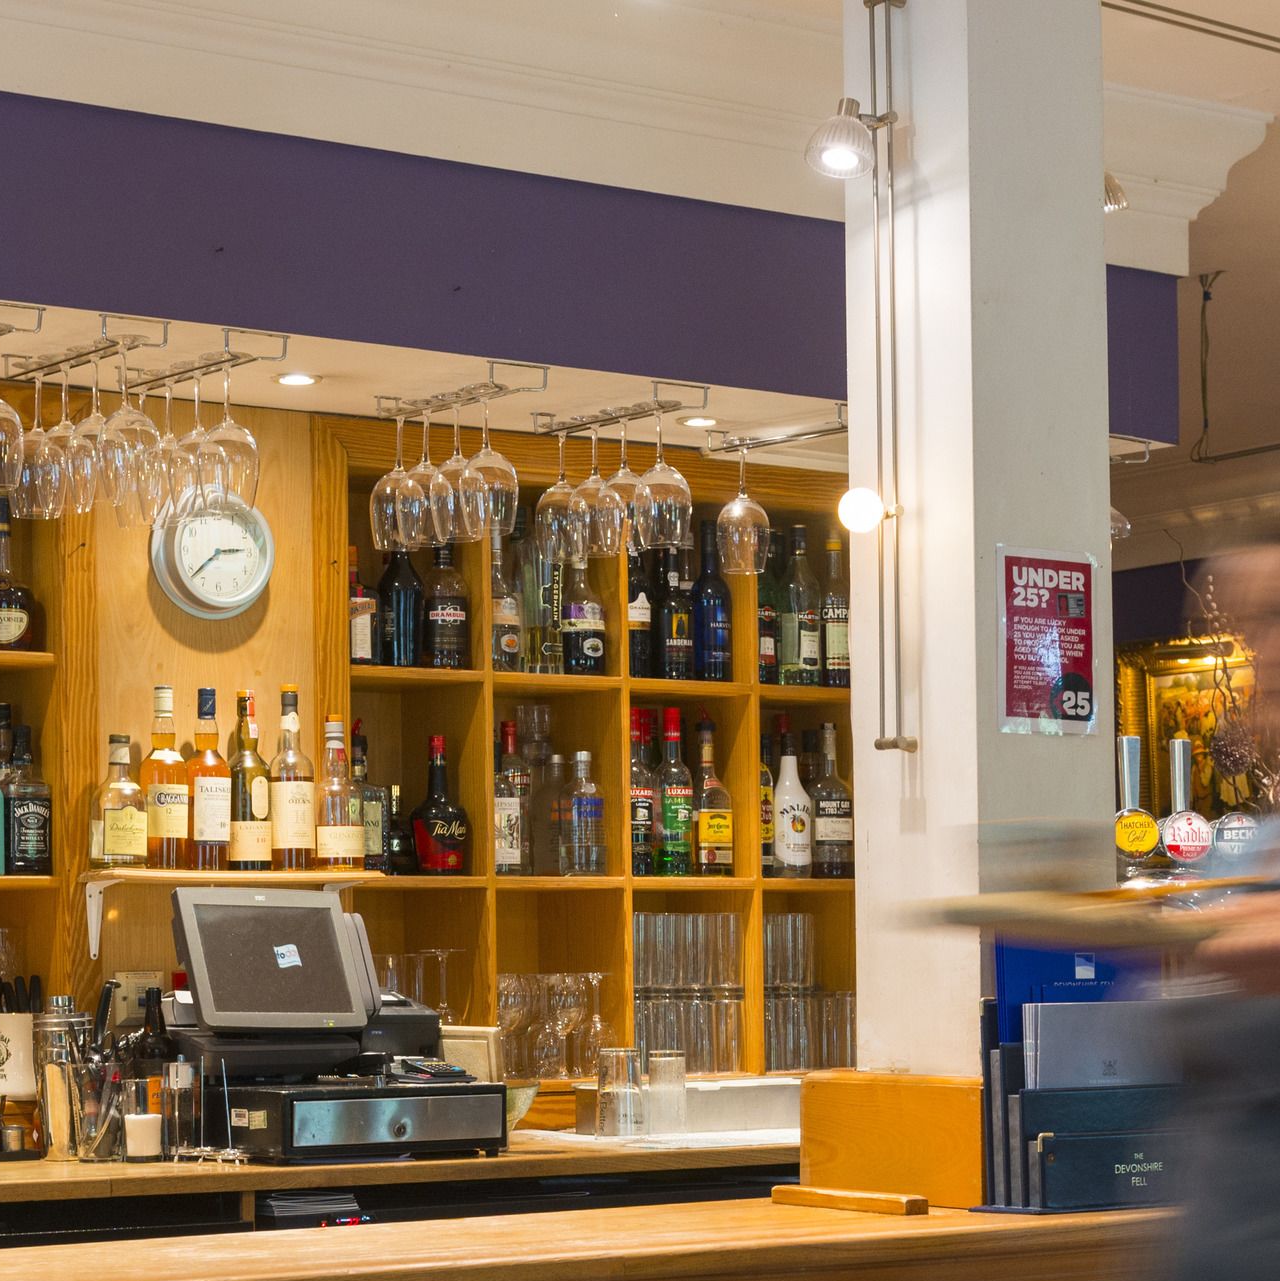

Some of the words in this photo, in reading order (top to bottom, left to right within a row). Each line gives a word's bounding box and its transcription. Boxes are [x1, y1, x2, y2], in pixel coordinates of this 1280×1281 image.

[1013, 566, 1085, 592] UNDER
[1013, 588, 1050, 608] 25?
[1020, 616, 1034, 624] YOU
[1014, 624, 1040, 632] ENOUGH
[1066, 628, 1086, 636] UNDER
[1028, 654, 1040, 662] BUY
[1066, 650, 1083, 658] WHEN
[1062, 690, 1090, 716] 25
[820, 800, 838, 808] MOUNT
[839, 800, 851, 808] GAY
[14, 803, 28, 817] JACK
[1120, 820, 1154, 830] THATCHERS
[1128, 829, 1146, 844] Gold
[1134, 1152, 1144, 1160] THE
[1114, 1162, 1163, 1175] DEVONSHIRE
[1132, 1176, 1148, 1186] FELL
